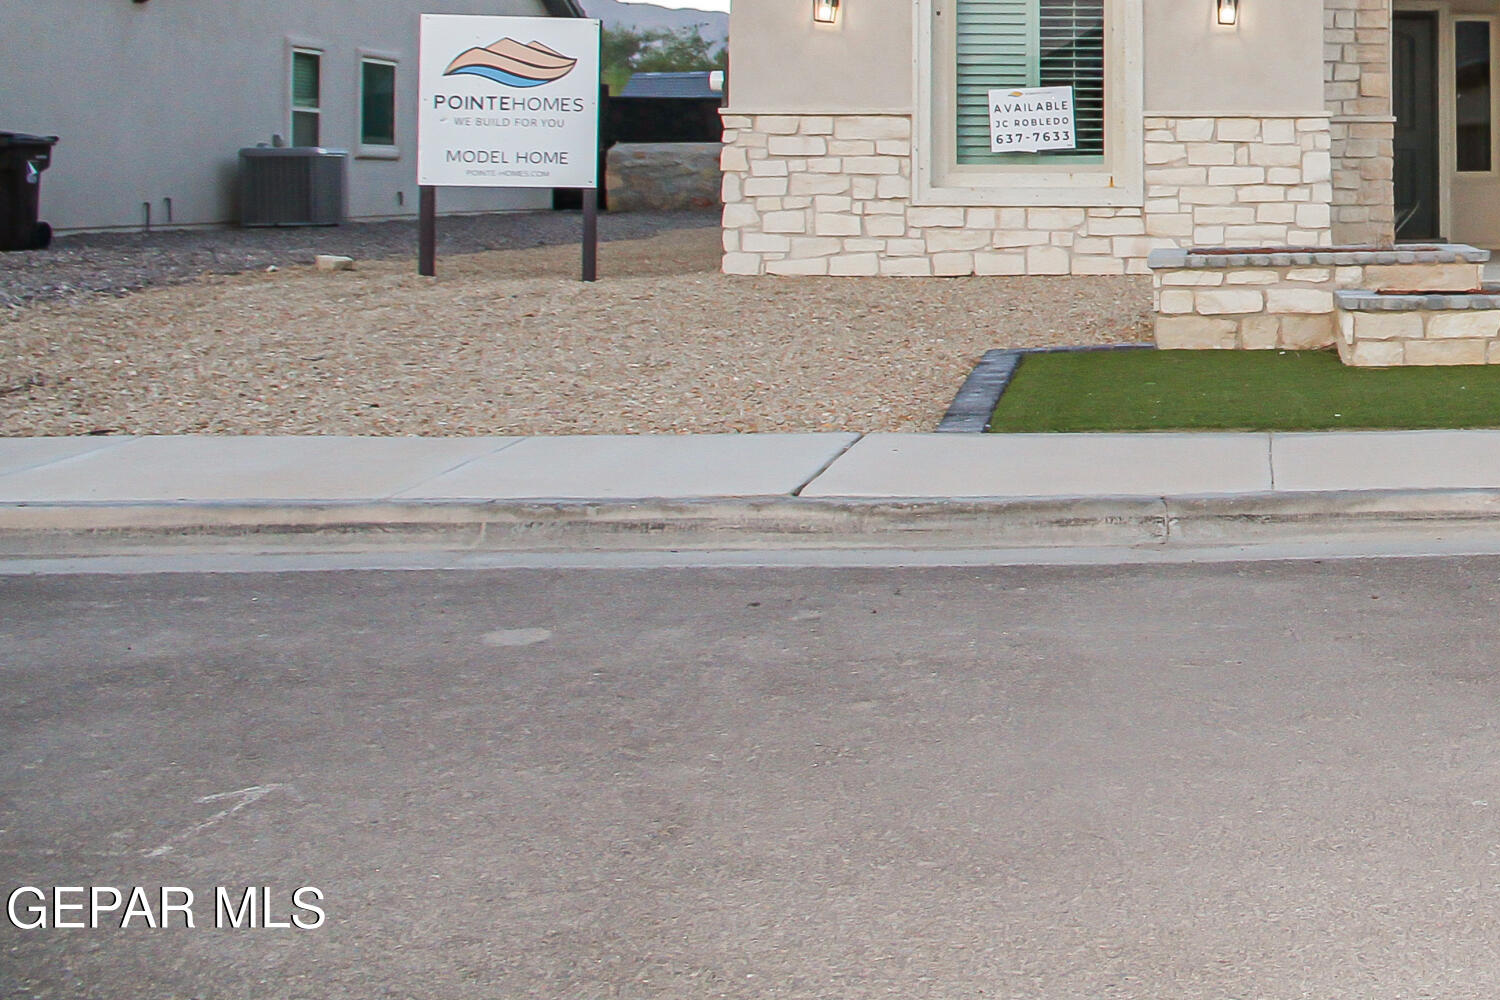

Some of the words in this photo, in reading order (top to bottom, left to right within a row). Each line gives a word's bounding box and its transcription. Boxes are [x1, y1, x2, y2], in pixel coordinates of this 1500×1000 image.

[434, 95, 584, 112] POINTEHOMES
[994, 101, 1068, 113] AVAILABLE
[454, 117, 471, 126] WE
[475, 118, 510, 127] BUILD
[514, 118, 537, 128] FOR
[541, 119, 565, 128] YOU
[995, 120, 1008, 128] JC
[1014, 117, 1069, 127] ROBLEDO
[996, 131, 1070, 144] 637-7633
[446, 150, 509, 164] MODEL
[516, 152, 568, 164] HOME
